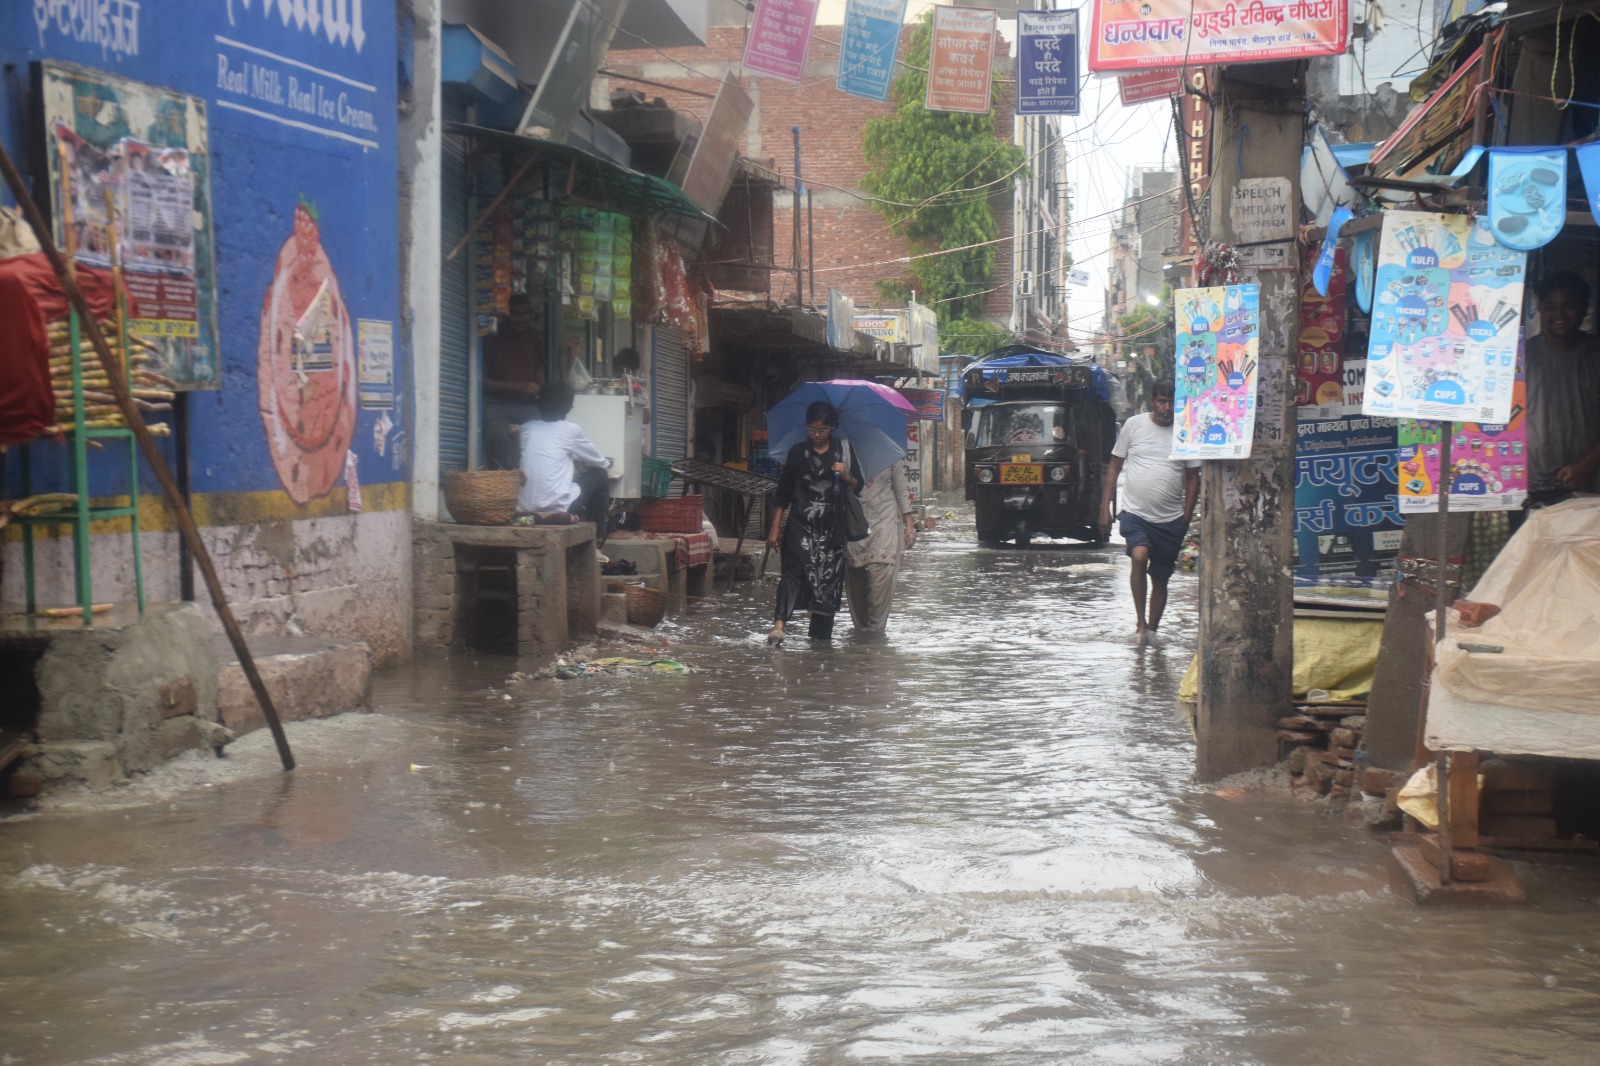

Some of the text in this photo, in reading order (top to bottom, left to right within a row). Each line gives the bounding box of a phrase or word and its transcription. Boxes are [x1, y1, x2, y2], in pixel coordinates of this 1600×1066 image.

[1103, 18, 1186, 44] धन्यवाद
[938, 35, 989, 51] सोफा सेट
[1034, 35, 1062, 51] परदे
[1209, 39, 1227, 47] निगम
[1251, 34, 1276, 46] मीठापुर
[1302, 32, 1317, 40] 182
[948, 53, 976, 65] कवर
[1034, 58, 1062, 73] परदे
[216, 53, 378, 134] Real Milk. Real Ice Cream.
[1410, 255, 1435, 266] KULFI
[1395, 307, 1426, 316] TRICONES
[857, 320, 886, 328] SOON
[1469, 327, 1494, 337] STICKS
[1433, 389, 1457, 400] CUPS
[1297, 423, 1315, 437] द्वारा
[1317, 420, 1348, 433] मान्यता
[1350, 418, 1369, 431] प्राप्त
[1482, 424, 1504, 432] STICKS
[1208, 433, 1223, 441] CUPS
[1458, 482, 1480, 491] CUPS
